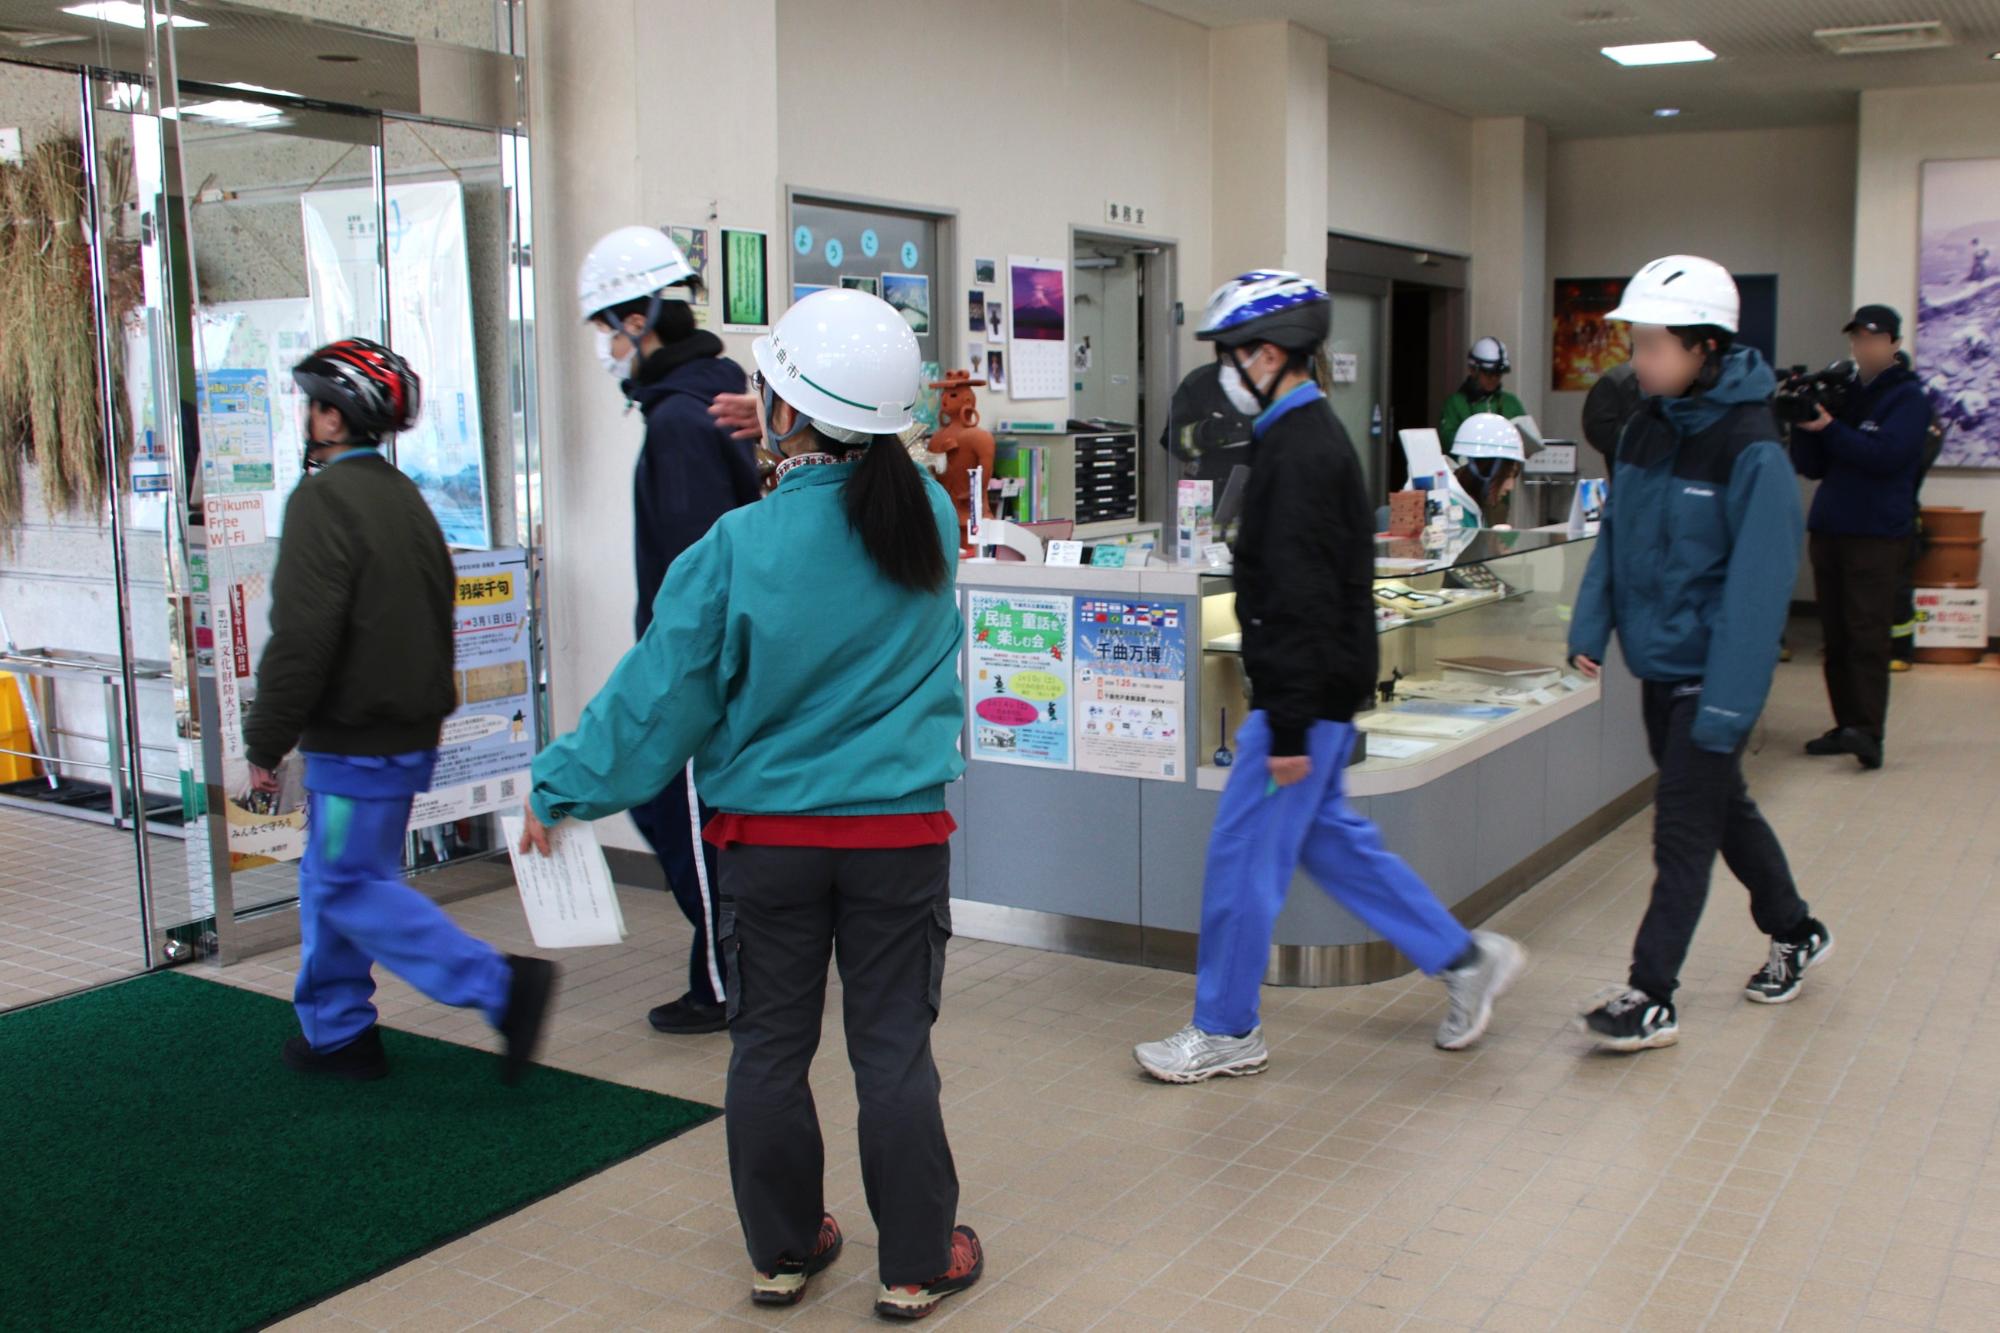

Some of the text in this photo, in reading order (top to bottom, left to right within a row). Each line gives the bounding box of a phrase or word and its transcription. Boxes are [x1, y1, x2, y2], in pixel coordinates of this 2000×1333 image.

[799, 230, 912, 262] ようこそ
[772, 335, 799, 379] 千曲市
[207, 499, 260, 513] Chikuma
[209, 517, 239, 529] Free
[210, 530, 245, 545] W-Fi
[459, 580, 509, 600] 羽柴千句
[997, 629, 1043, 649] 楽しむ会
[1097, 643, 1162, 664] 千曲万博
[232, 818, 291, 838] みんなで守ろう
